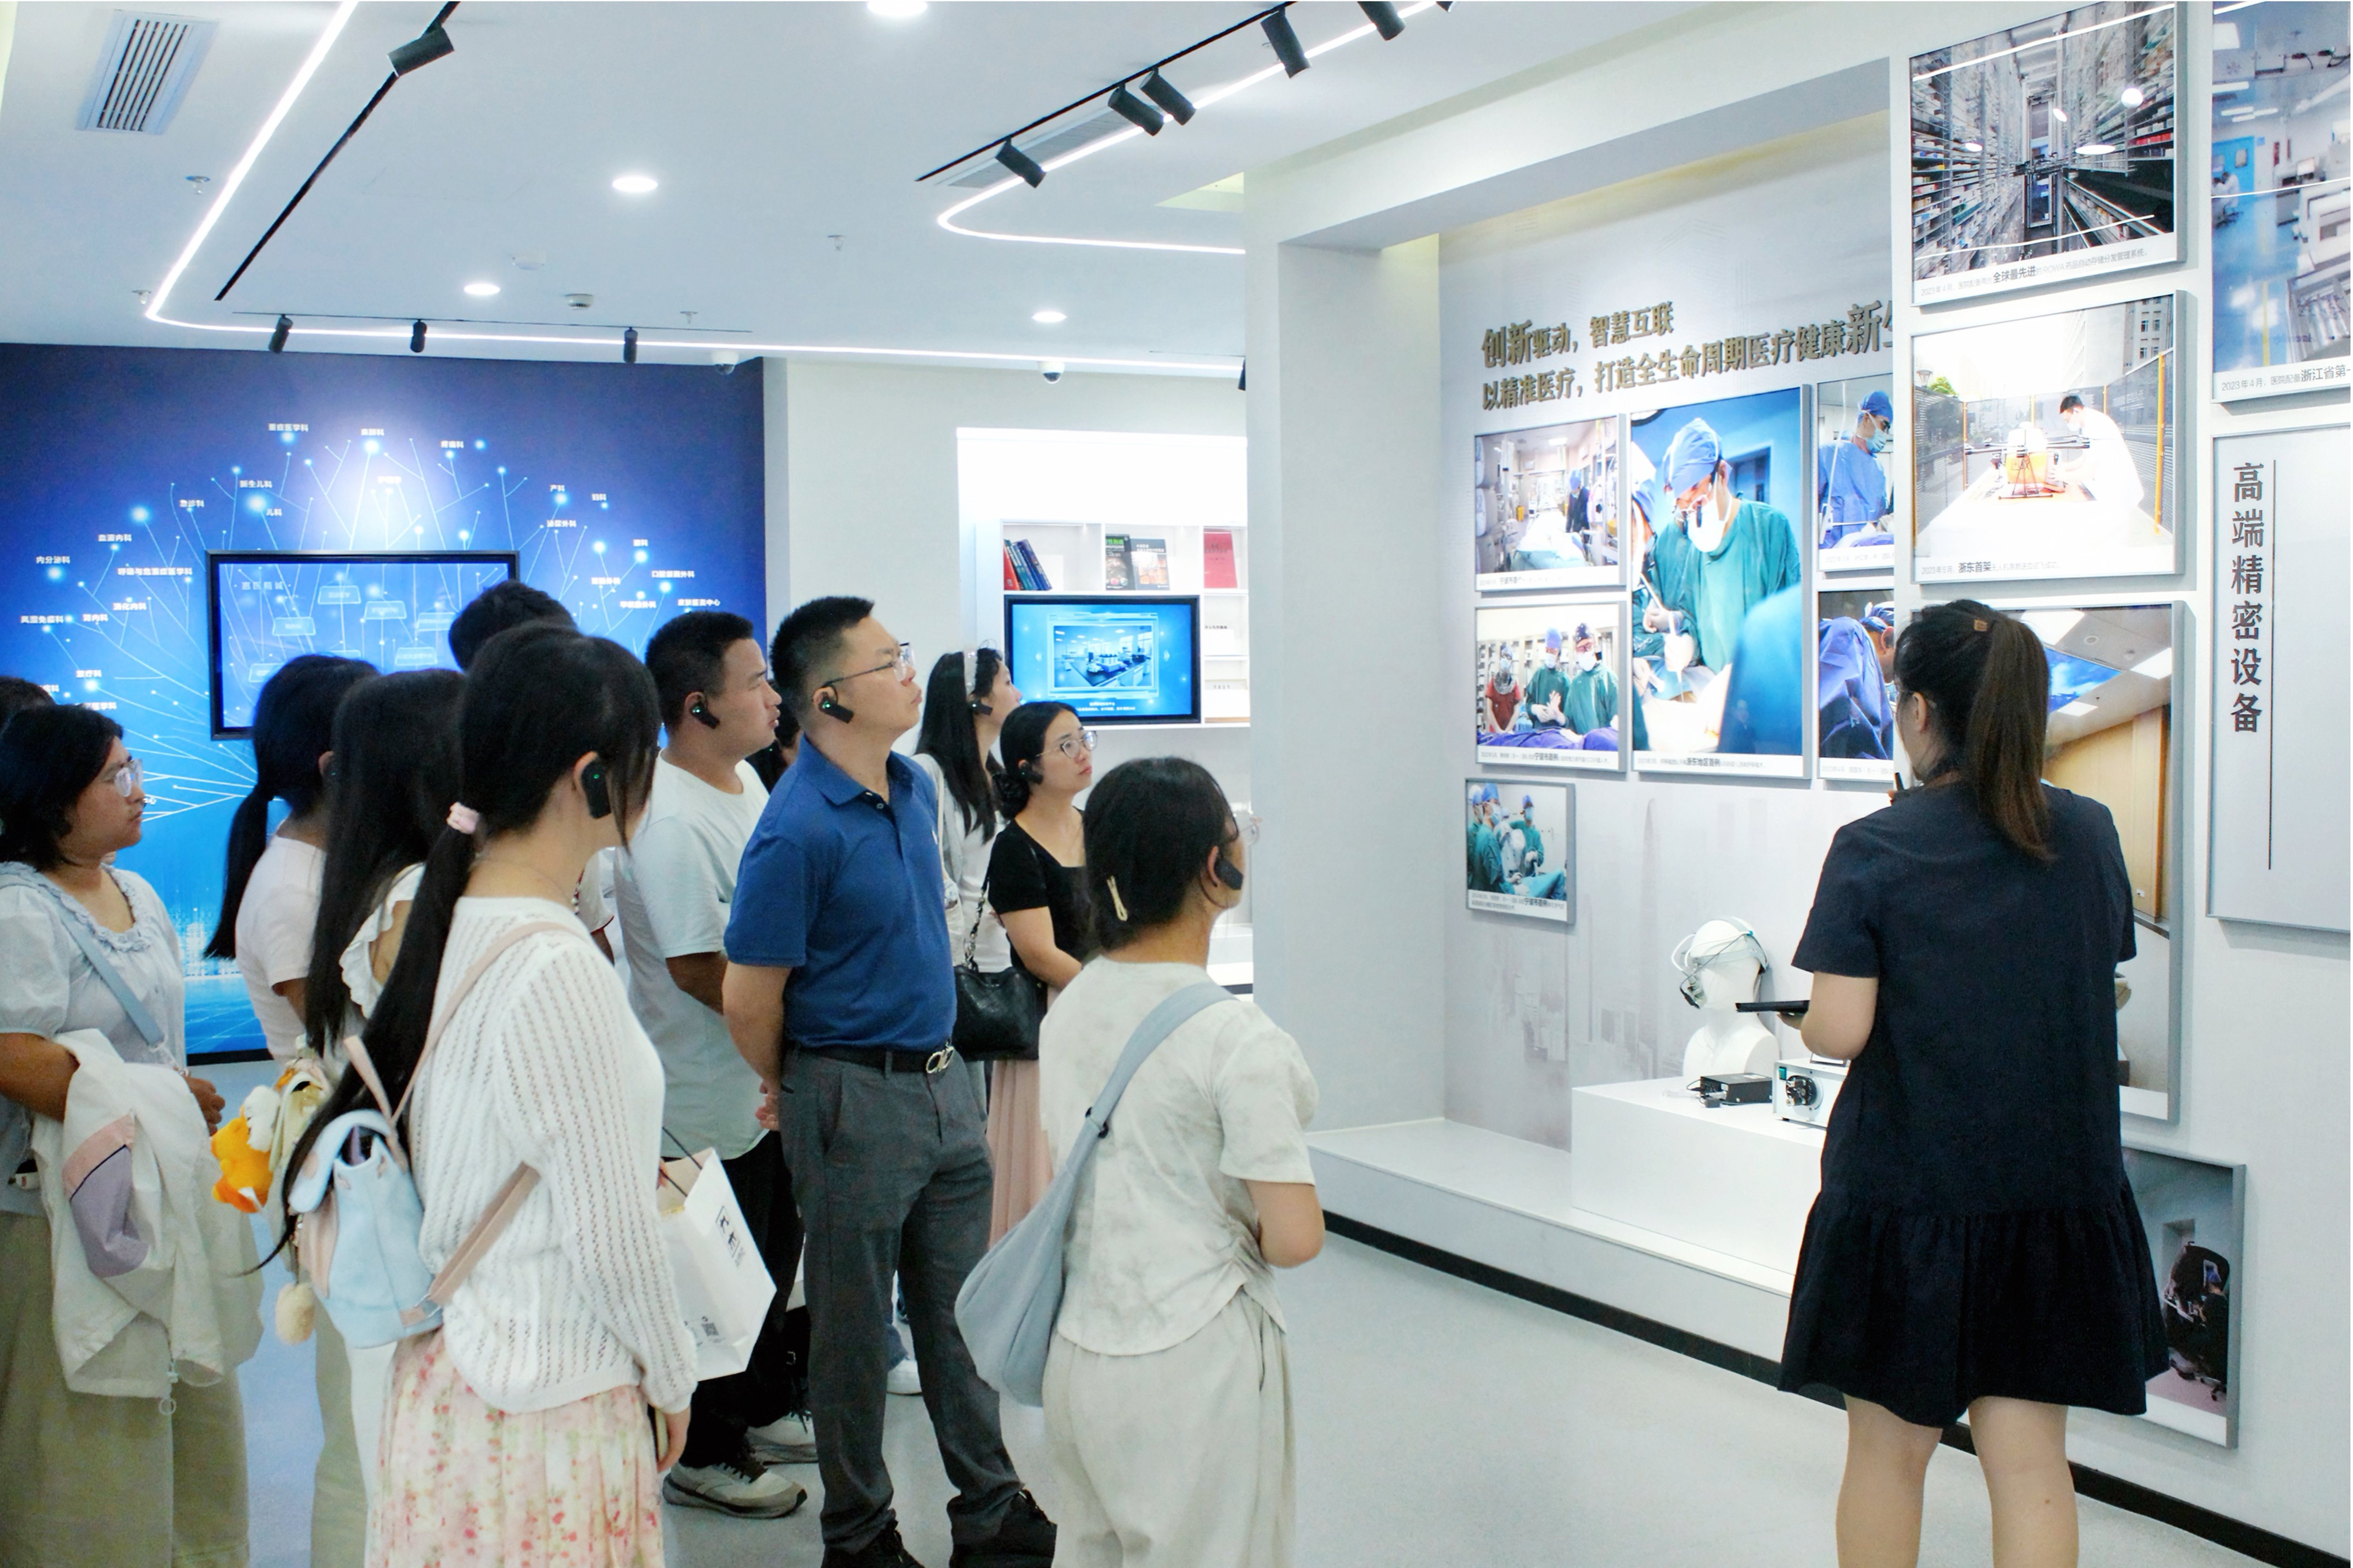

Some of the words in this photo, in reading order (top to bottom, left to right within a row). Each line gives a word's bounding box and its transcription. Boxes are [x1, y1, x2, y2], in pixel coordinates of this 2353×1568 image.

[1481, 301, 1674, 369] 创新驱动，智慧互联
[269, 423, 309, 431] 重症医学科
[240, 480, 272, 488] 新生儿科
[180, 499, 204, 509] 急诊科
[2231, 462, 2264, 733] 高端精密设备
[113, 602, 146, 610] 消化内科
